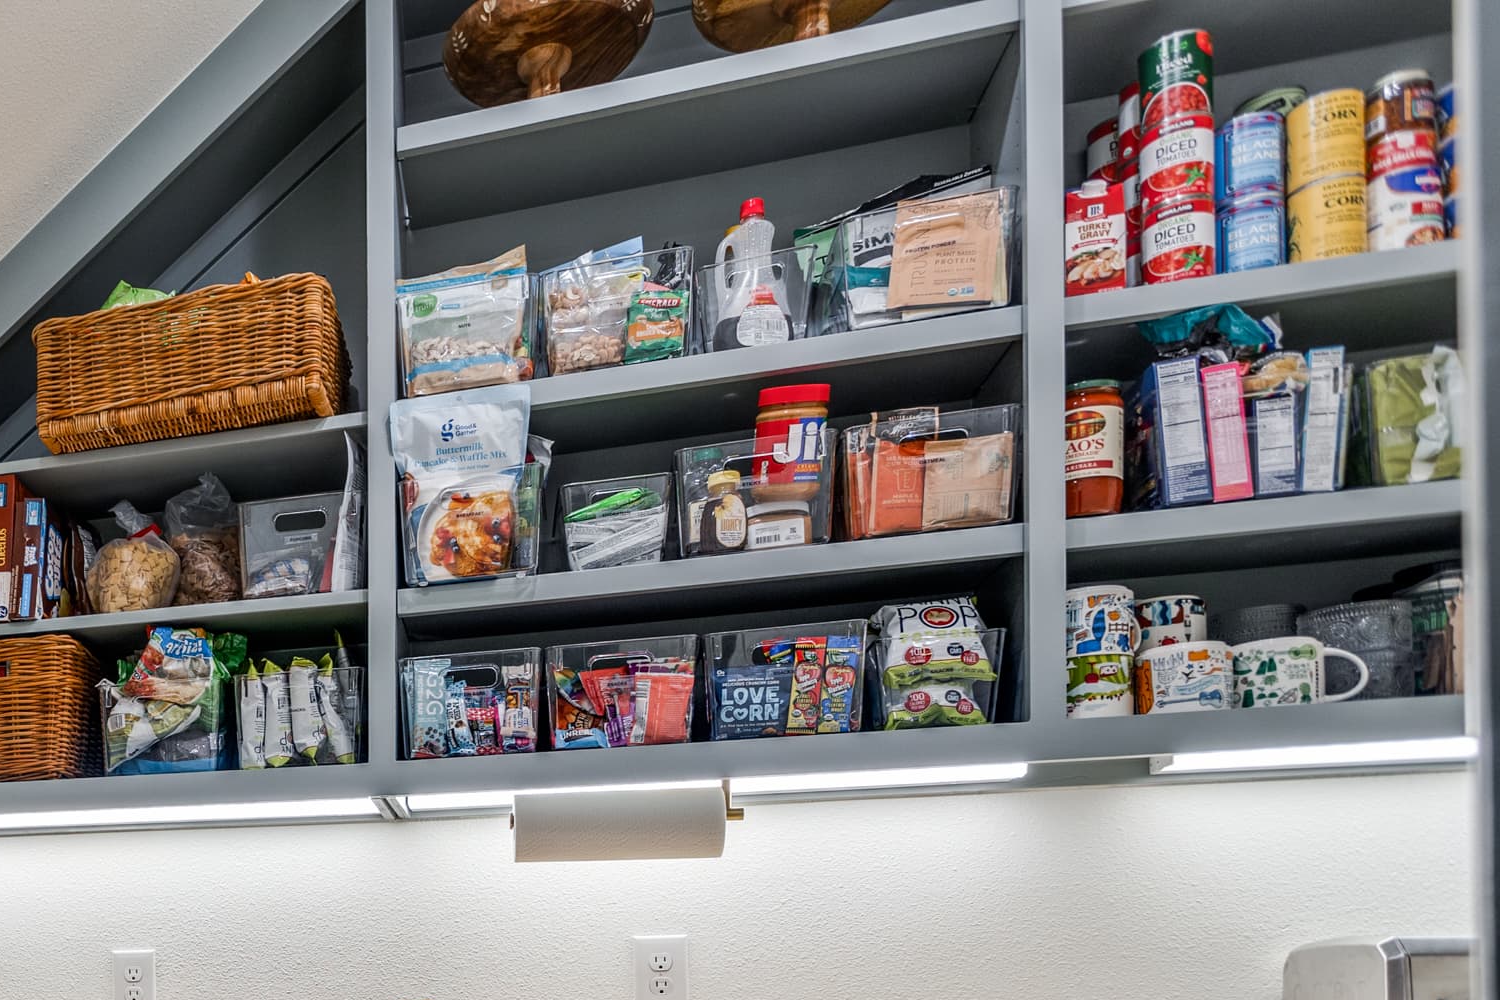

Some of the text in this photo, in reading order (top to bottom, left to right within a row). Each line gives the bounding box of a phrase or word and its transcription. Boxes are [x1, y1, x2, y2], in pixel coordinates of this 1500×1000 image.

[1155, 138, 1197, 159] DICED
[1232, 138, 1280, 154] BLACK
[1156, 150, 1197, 166] TOMATOES
[1232, 150, 1280, 166] BEANS
[1077, 221, 1113, 234] TURKEY
[1080, 230, 1111, 241] GRAVY
[1154, 222, 1196, 244] DICED
[1228, 222, 1277, 239] BLACK
[1155, 234, 1196, 251] TOMATOES
[1228, 235, 1278, 252] BEANS
[934, 257, 976, 265] PROTEIN
[640, 298, 679, 307] EMERALD
[436, 442, 484, 456] Buttermilk
[772, 421, 827, 464] Jif
[1066, 439, 1105, 455] AO'S
[459, 452, 489, 462] Waffle
[490, 449, 508, 458] Mix
[919, 457, 946, 465] OATMEAL
[1066, 462, 1098, 471] ARINARA
[722, 518, 741, 532] HONEY
[897, 605, 978, 633] POP
[426, 674, 445, 716] G2G
[721, 686, 784, 706] LOVE,
[720, 703, 780, 723] CORN
[563, 728, 595, 738] UNREAL
